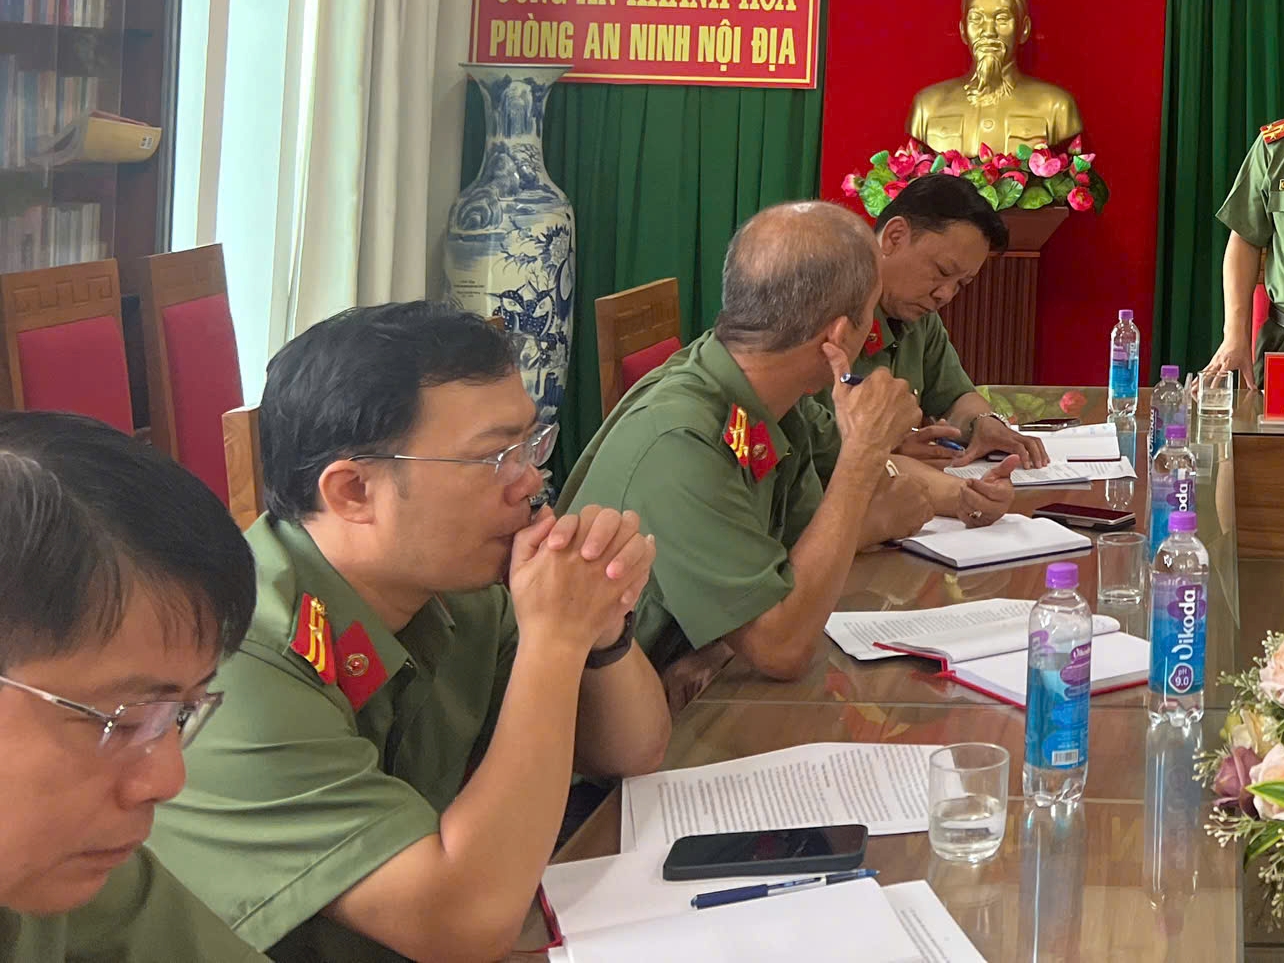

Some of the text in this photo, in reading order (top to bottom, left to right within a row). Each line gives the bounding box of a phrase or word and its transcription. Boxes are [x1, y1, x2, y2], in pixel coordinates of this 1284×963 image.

[489, 13, 797, 73] PHÒNG AN NINH NỘI ĐỊA
[1175, 483, 1188, 512] oda
[1171, 589, 1196, 660] Vikoda
[1175, 677, 1189, 686] 9.0
